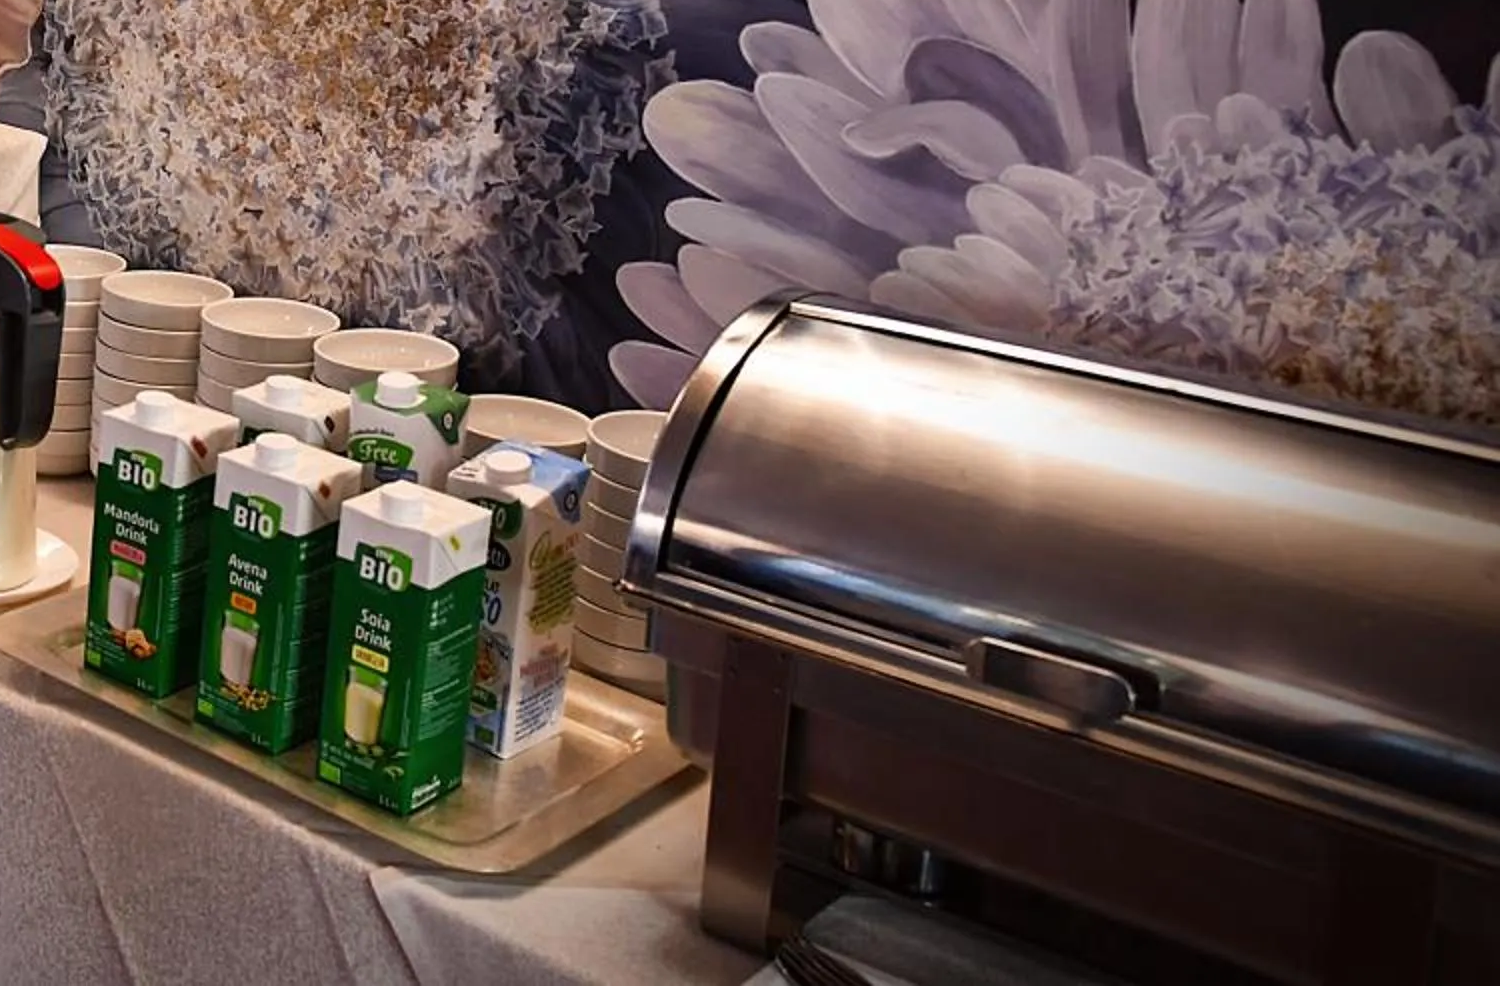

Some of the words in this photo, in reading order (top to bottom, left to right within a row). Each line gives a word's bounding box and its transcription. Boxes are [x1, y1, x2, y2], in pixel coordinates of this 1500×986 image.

[359, 439, 399, 465] Free
[117, 458, 157, 491] BIO
[103, 502, 160, 534] Mandorla
[233, 503, 274, 539] BIO
[115, 523, 148, 546] Drink
[227, 553, 268, 581] Avena
[360, 554, 404, 591] BIO
[228, 571, 263, 597] Drink
[360, 608, 391, 633] Soia
[355, 625, 392, 653] Drink
